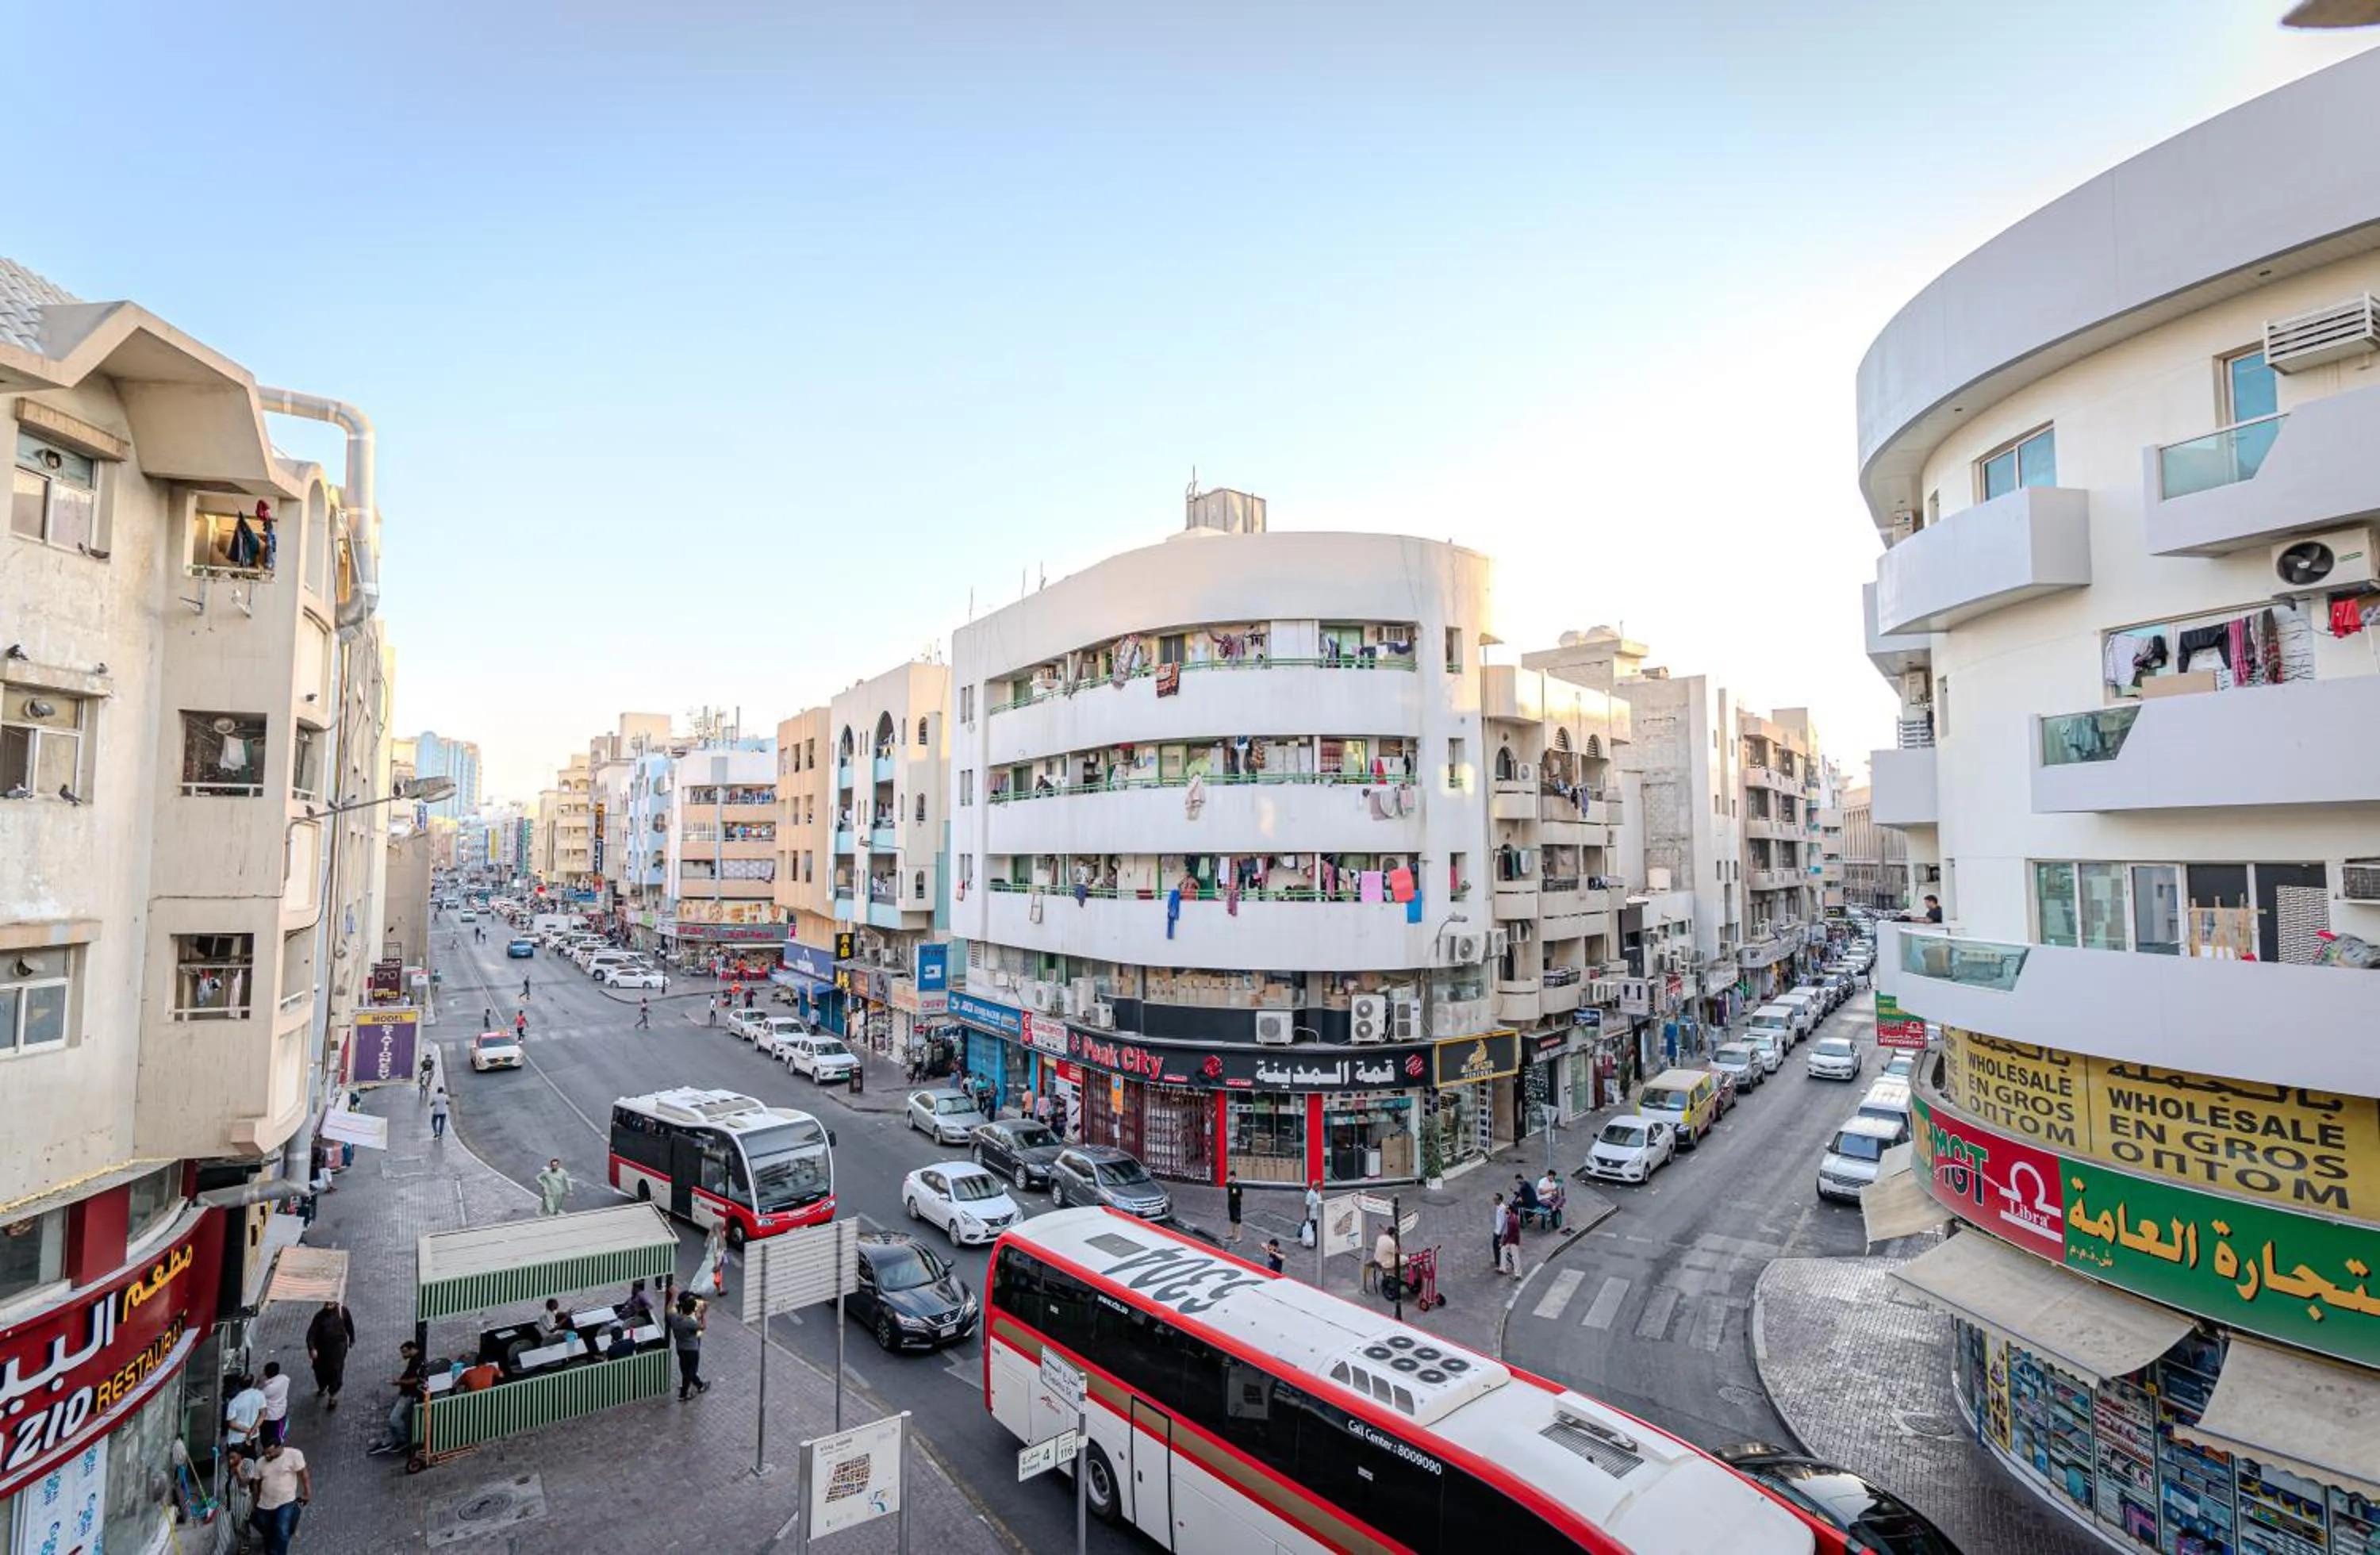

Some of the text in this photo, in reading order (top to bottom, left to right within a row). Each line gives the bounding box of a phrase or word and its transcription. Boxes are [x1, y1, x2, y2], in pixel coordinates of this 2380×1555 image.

[1082, 1035, 1164, 1080] Peak City
[1256, 1059, 1395, 1092] قمة المدينة
[1967, 1050, 2073, 1098] WHOLESALE
[1969, 1073, 2075, 1123] EN GROS
[1969, 1095, 2076, 1147] ОПТОМ
[2108, 1087, 2346, 1150] WHOLESALE
[2109, 1114, 2349, 1180] EN GROS
[2111, 1141, 2350, 1210] ОПТОМ
[2010, 1200, 2049, 1228] Libra
[2068, 1177, 2380, 1322] تجارة العامة
[123, 1244, 193, 1323] مطعم
[0, 1291, 117, 1415] البي
[0, 1386, 93, 1471] ZIO
[1043, 1448, 1050, 1461] 4
[1348, 1419, 1365, 1437] Call
[1365, 1428, 1392, 1451] Center
[1397, 1444, 1442, 1476] 8009090
